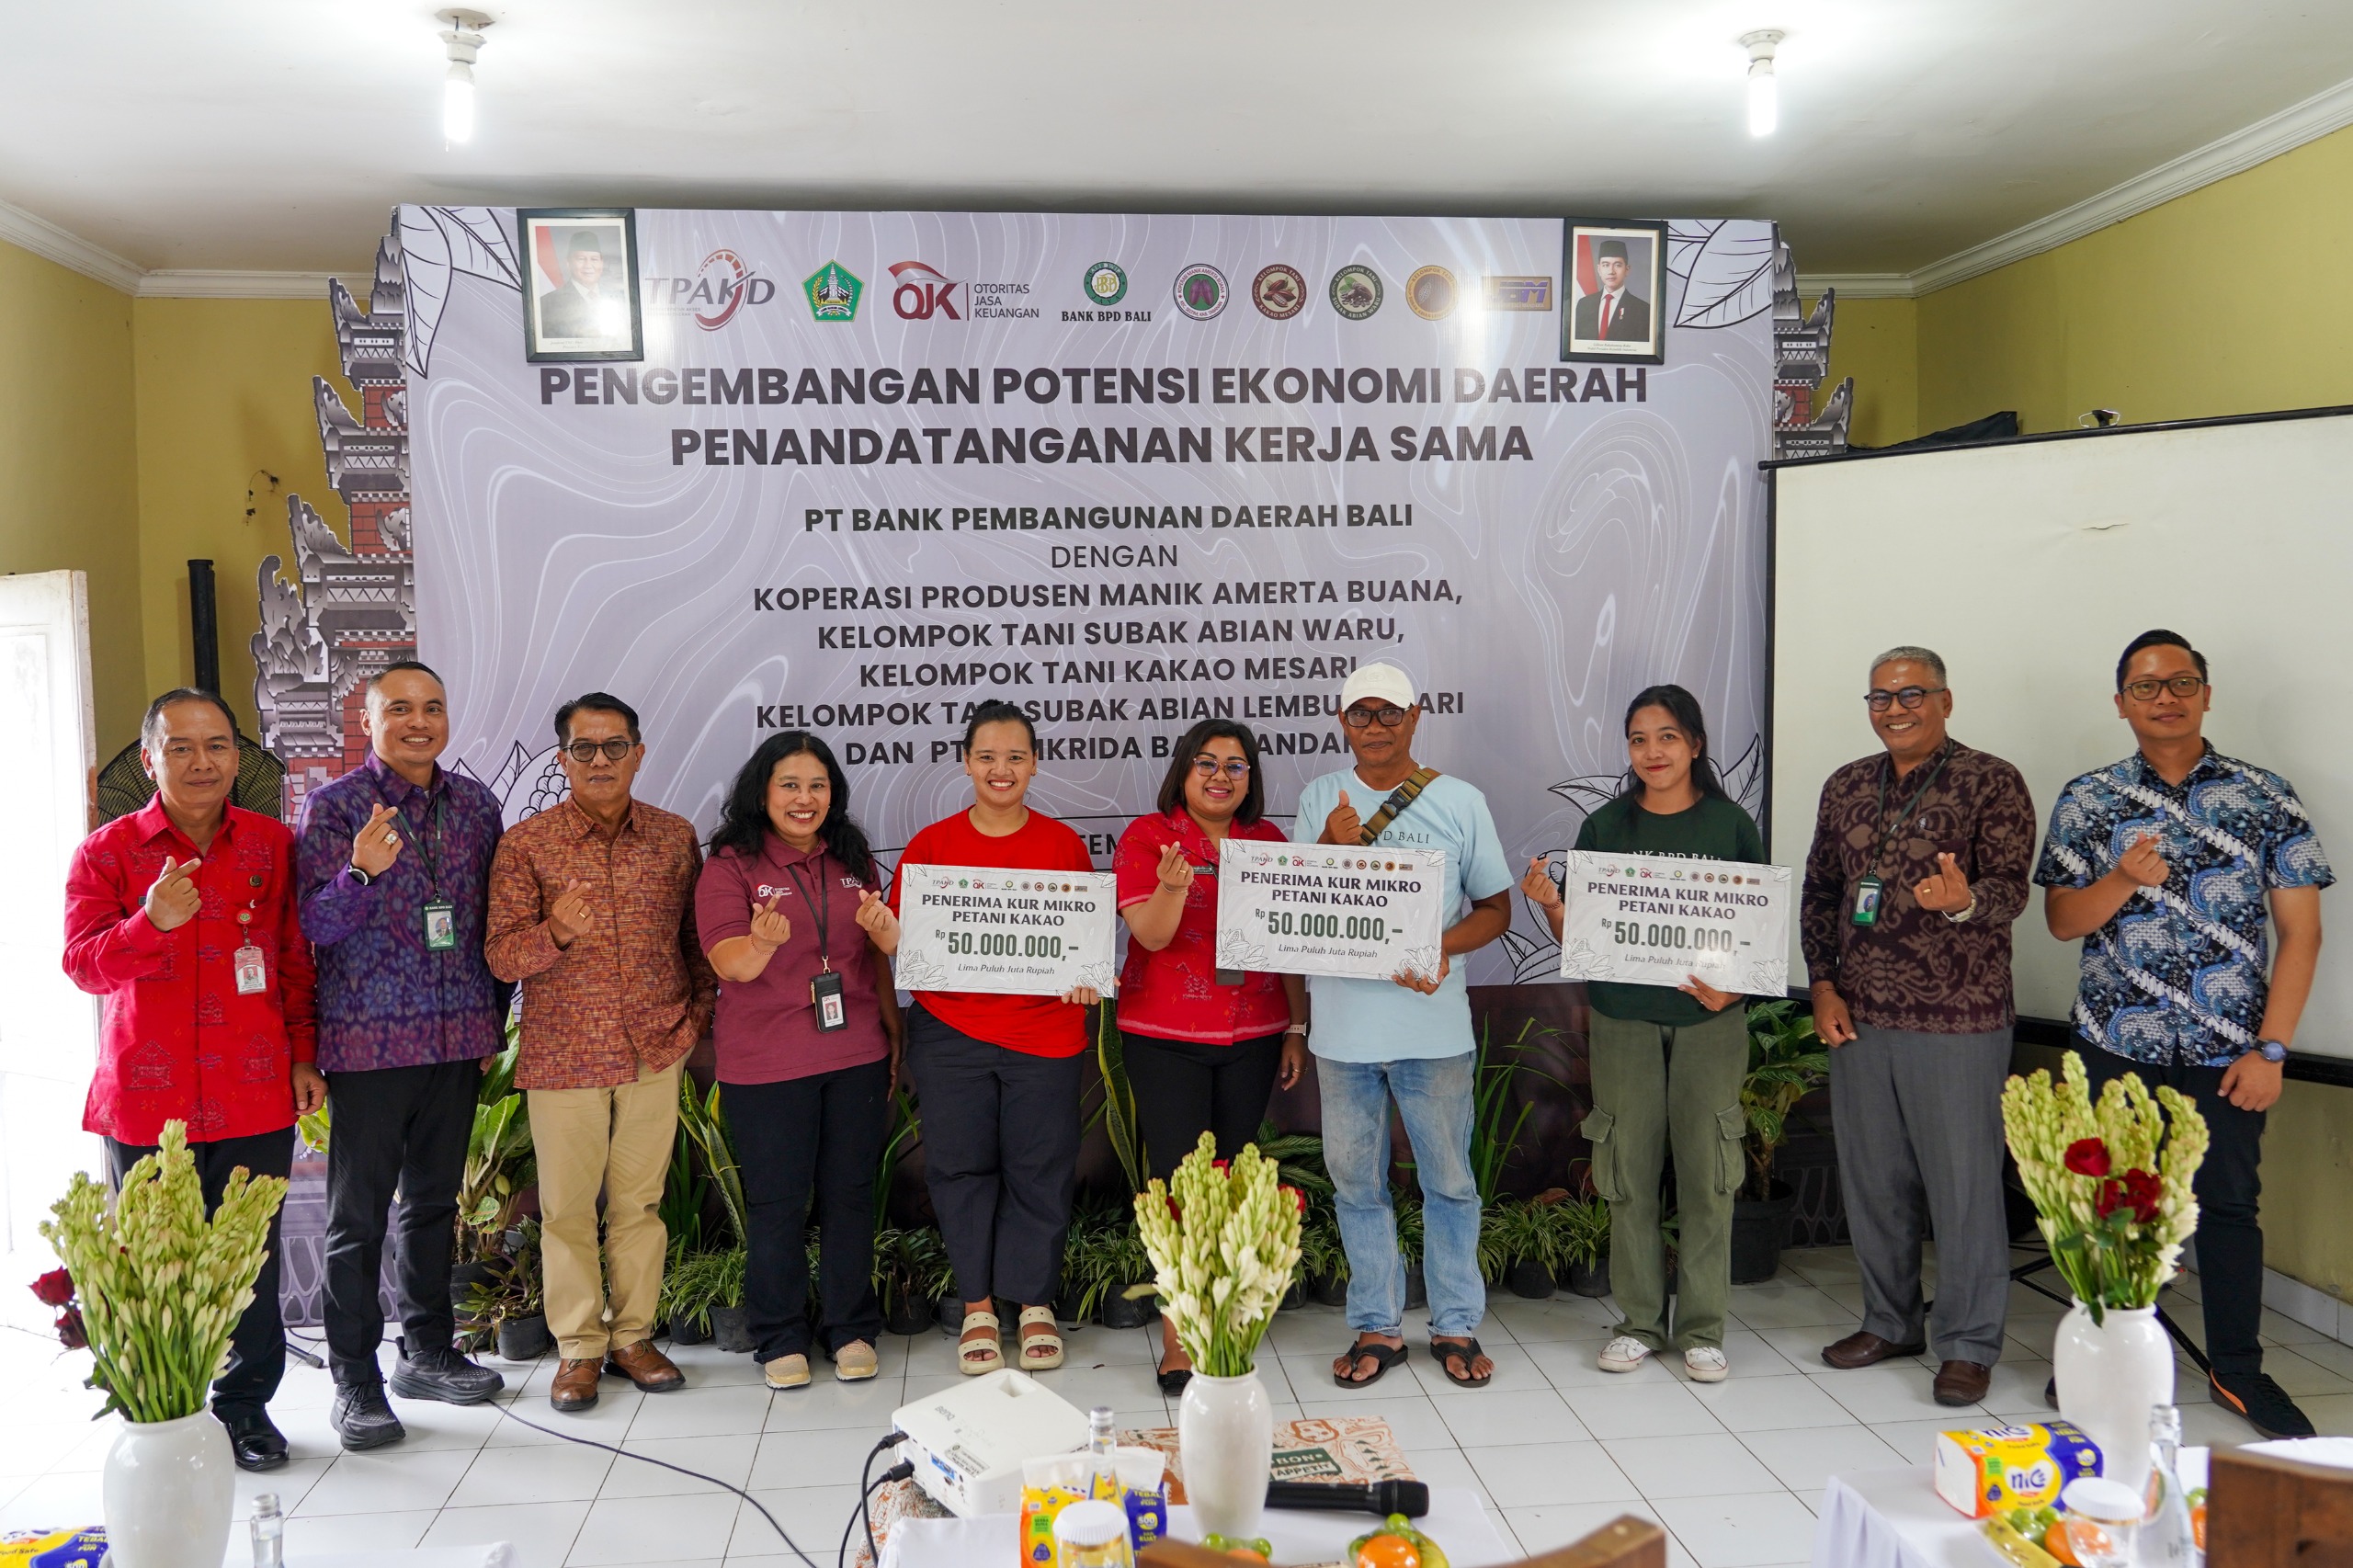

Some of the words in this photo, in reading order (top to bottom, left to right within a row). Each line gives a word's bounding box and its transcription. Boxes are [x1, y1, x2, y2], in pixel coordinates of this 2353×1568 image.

[1257, 267, 1288, 282] KELOMPOK
[1289, 269, 1301, 282] TANI
[1336, 267, 1364, 282] KELOMPOK
[1366, 269, 1377, 282] TANI
[974, 283, 1030, 294] OTORITAS
[974, 295, 1003, 306] JASA
[1333, 297, 1347, 315] SUBAK
[1369, 297, 1381, 313] WARU
[974, 307, 1040, 319] KEUANGAN
[1062, 312, 1094, 322] BANK
[1097, 312, 1121, 322] BPD
[1124, 312, 1152, 322] BALI
[1259, 304, 1279, 318] KAKAO
[1279, 304, 1301, 318] MESARI
[540, 368, 979, 405] PENGEMBANGAN
[994, 368, 1199, 404] POTENSI
[1213, 368, 1440, 404] EKONOMI
[1454, 368, 1647, 403] DAERAH
[672, 427, 1211, 465] PENANDATANGANAN
[1226, 426, 1380, 462] KERJA
[1391, 426, 1533, 461] SAMA
[805, 508, 843, 531] PT
[853, 508, 943, 531] BANK
[952, 506, 1201, 530] PEMBANGUNAN
[1212, 506, 1337, 528] DAERAH
[1347, 505, 1413, 527] BALI
[1051, 545, 1177, 568] DENGAN
[755, 586, 912, 610] KOPERASI
[923, 585, 1090, 608] PRODUSEN
[1100, 583, 1204, 606] MANIK
[1212, 581, 1338, 604] AMERTA
[1348, 580, 1462, 604] BUANA,
[818, 624, 992, 649] KELOMPOK
[1002, 623, 1074, 646] TANI
[1085, 621, 1188, 644] SUBAK
[1198, 619, 1293, 643] ABIAN
[1302, 619, 1404, 642] WARU,
[860, 662, 1033, 687] KELOMPOK
[1042, 661, 1115, 684] TANI
[1124, 659, 1234, 682] KAKAO
[756, 702, 932, 728] KELOMPOK
[1024, 699, 1129, 722] SUBAK
[1138, 697, 1233, 720] ABIAN
[1418, 692, 1464, 714] ARI
[847, 742, 914, 765] DAN
[931, 740, 963, 763] PT
[1398, 831, 1429, 844] BALI
[1241, 871, 1323, 888] PENERIMA
[1327, 877, 1361, 890] KUR
[1366, 879, 1422, 893] MIKRO
[1272, 890, 1326, 904] PETANI
[1331, 892, 1388, 907] KAKAO
[1587, 881, 1671, 899] PENERIMA
[1676, 889, 1710, 903] KUR
[1714, 892, 1768, 906] MIKRO
[922, 894, 1002, 909] PENERIMA
[1006, 898, 1040, 911] KUR
[1043, 899, 1096, 913] MIKRO
[1619, 900, 1674, 915] PETANI
[1678, 904, 1736, 920] KAKAO
[952, 911, 1006, 924] PETANI
[1010, 913, 1064, 926] KAKAO
[1255, 908, 1266, 919] Rp
[1267, 911, 1403, 945] 50.000.000,-
[936, 929, 946, 940] Rp
[949, 932, 1079, 961] 50.000.000,-
[1601, 918, 1612, 929] Rp
[1614, 921, 1751, 957] 50.000.000,-
[1279, 944, 1299, 953] Lima
[1302, 945, 1326, 955] Puluh
[1328, 947, 1346, 956] Juta
[1347, 948, 1378, 959] Rupiah
[1625, 953, 1645, 963] Lima
[1648, 955, 1673, 965] Puluh
[1677, 958, 1693, 967] Juta
[958, 963, 978, 972] Lima
[981, 964, 1004, 973] Puluh
[1006, 965, 1024, 974] Juta
[1026, 965, 1055, 976] Rupiah
[1276, 1454, 1315, 1465] BON
[1138, 1516, 1155, 1525] 500
